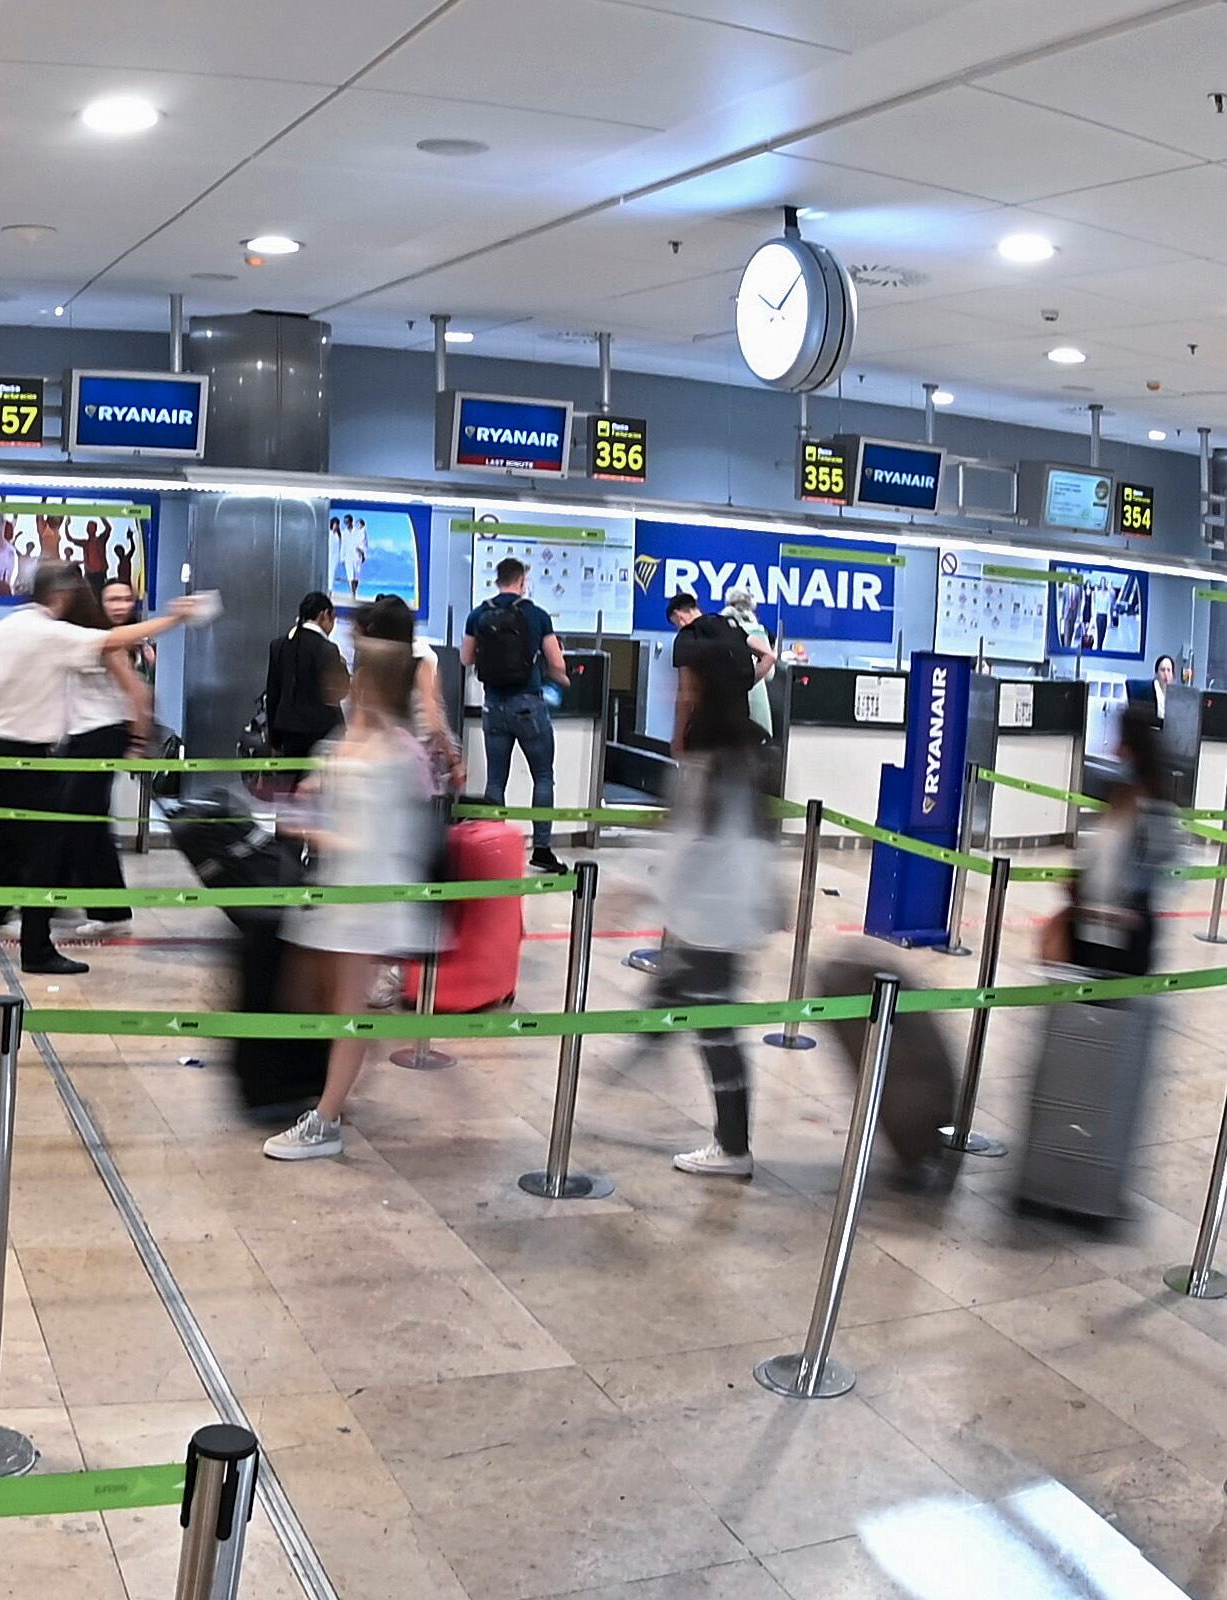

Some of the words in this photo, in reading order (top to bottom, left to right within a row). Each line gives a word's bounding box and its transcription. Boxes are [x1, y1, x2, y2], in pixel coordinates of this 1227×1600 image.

[98, 405, 193, 425] RYANAIR
[477, 427, 559, 448] RYANAIR
[596, 441, 643, 470] 356
[804, 465, 844, 493] 355
[874, 470, 935, 489] RYANAIR
[1123, 504, 1151, 530] 354
[664, 558, 882, 611] RYANAIR
[924, 666, 947, 794] RYANAIR
